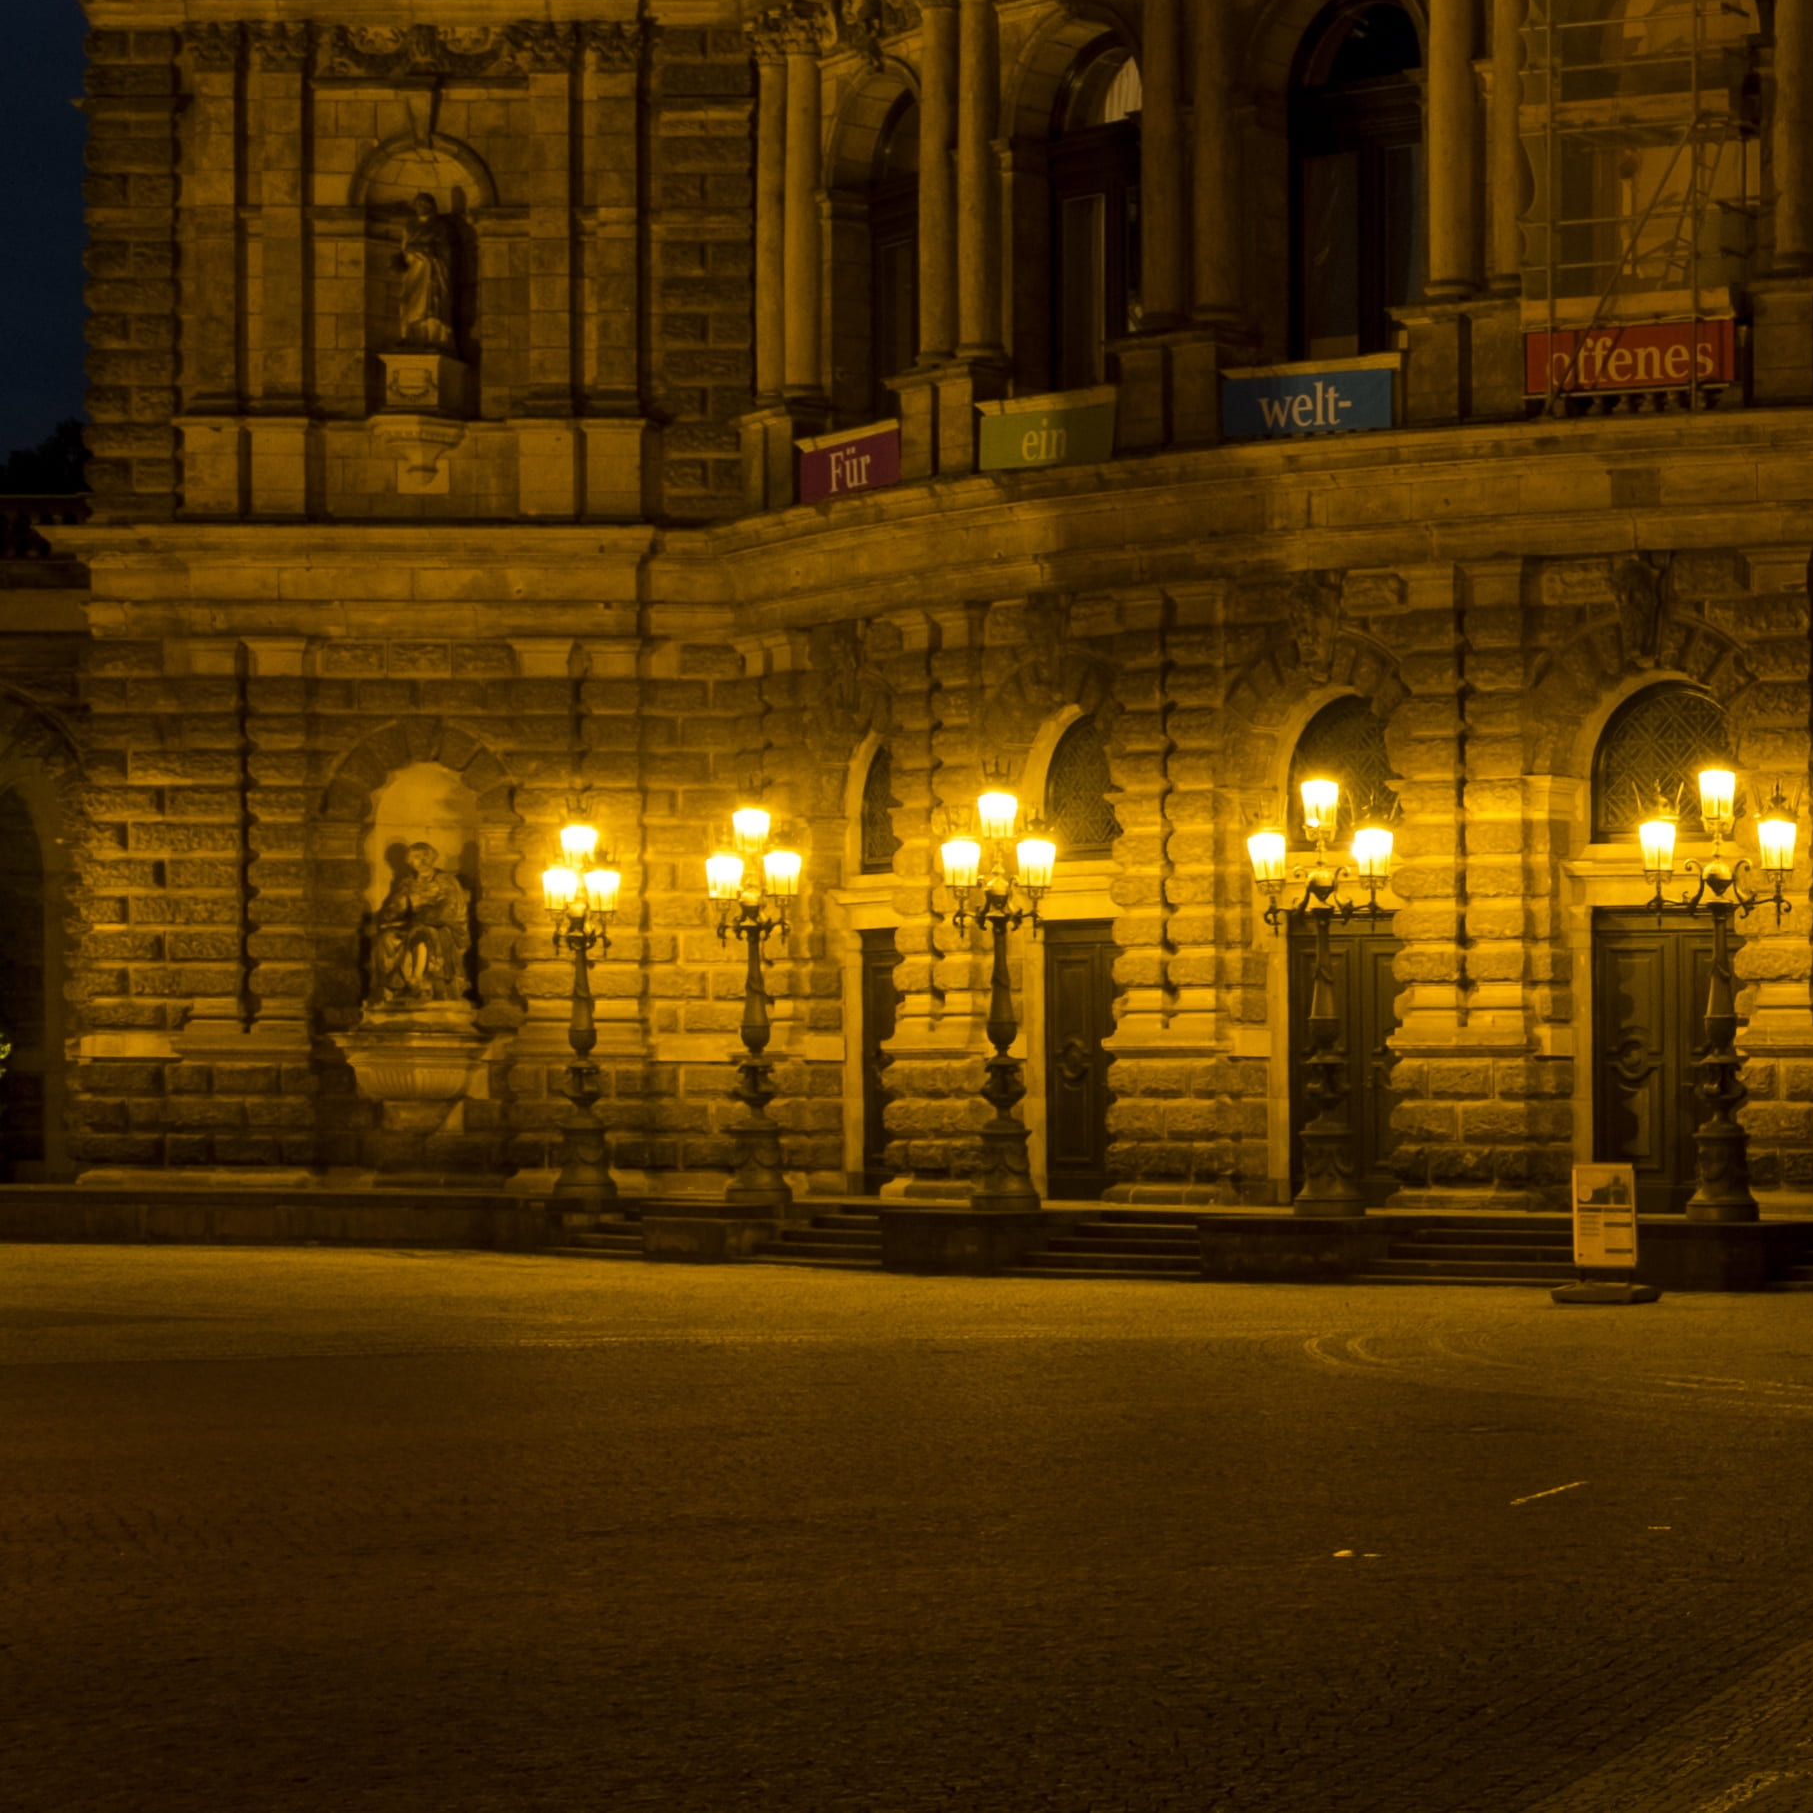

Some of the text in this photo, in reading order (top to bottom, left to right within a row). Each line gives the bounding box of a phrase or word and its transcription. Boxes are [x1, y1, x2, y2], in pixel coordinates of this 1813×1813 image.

[1258, 380, 1352, 429] welt-
[1021, 416, 1067, 461] ein
[829, 446, 871, 493] Für
